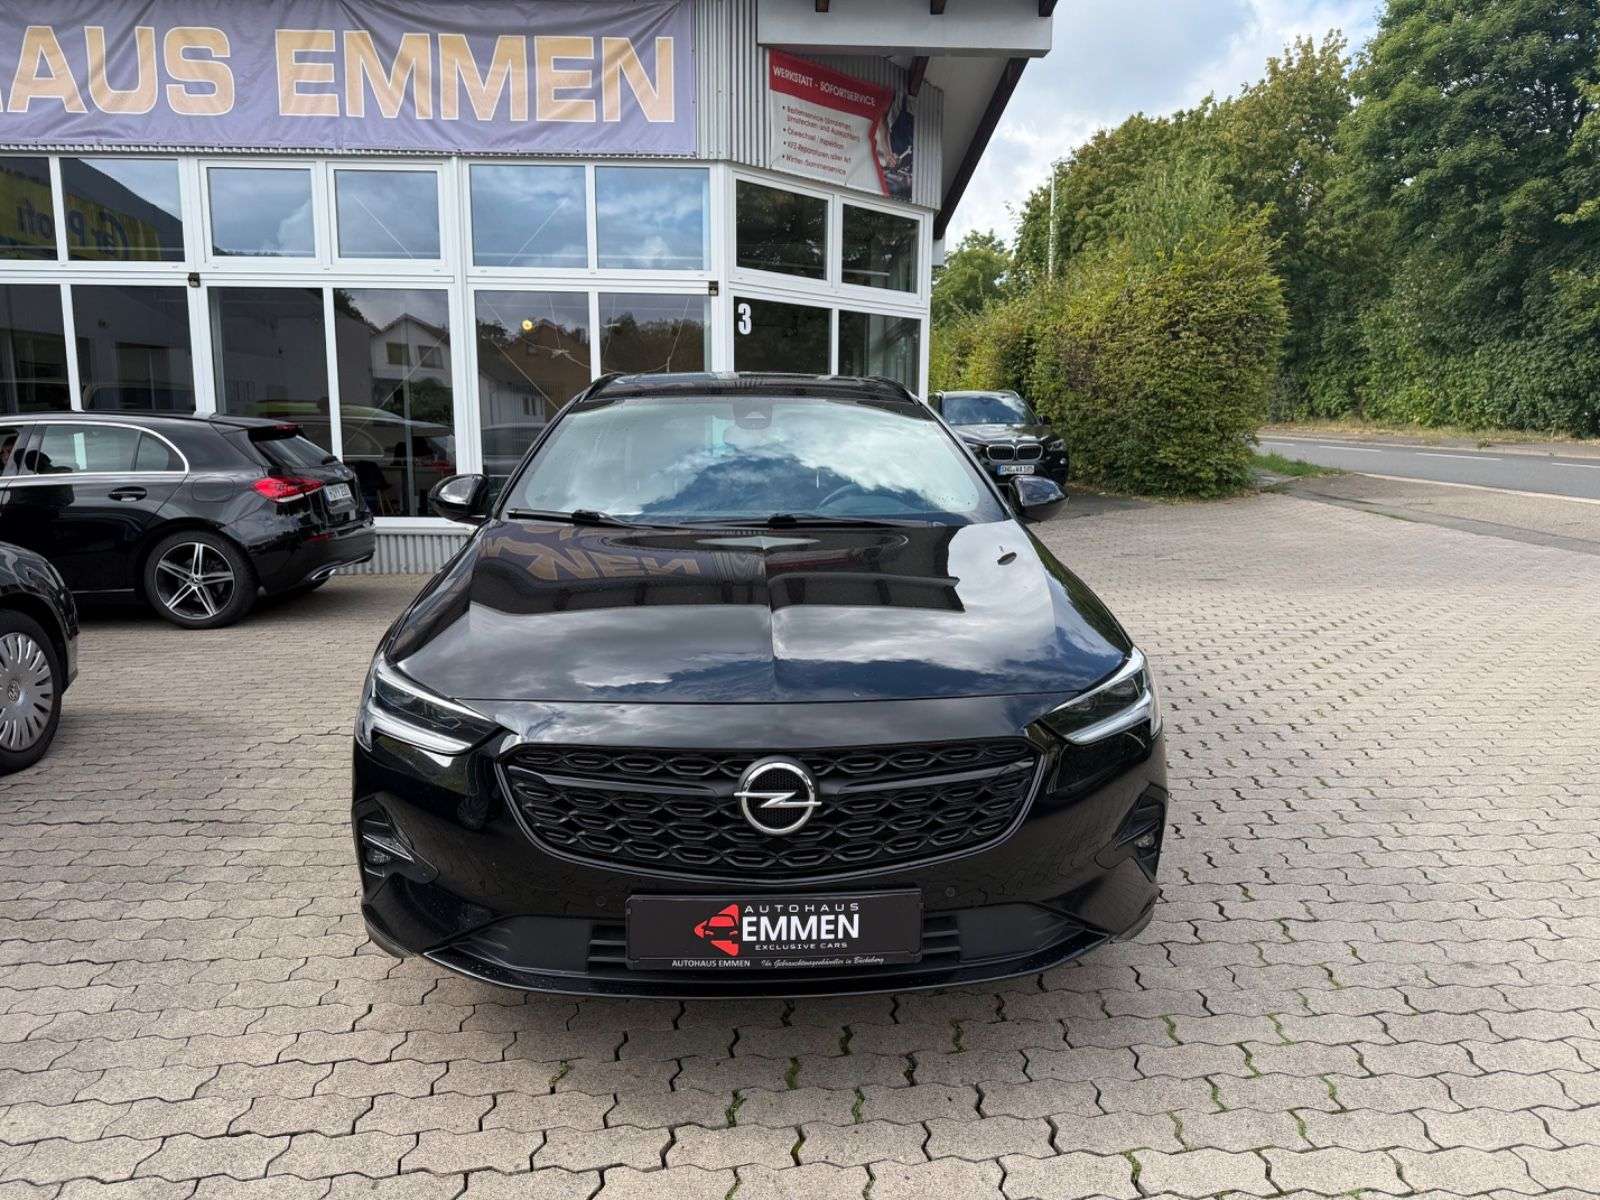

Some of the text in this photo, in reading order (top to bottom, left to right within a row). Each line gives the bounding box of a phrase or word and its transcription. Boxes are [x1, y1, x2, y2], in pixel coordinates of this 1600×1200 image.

[0, 26, 674, 122] AUS EMMEN
[773, 65, 813, 88] WERKSTATT
[820, 81, 876, 107] SOFORTSERVICE
[738, 303, 752, 335] 3
[744, 902, 859, 912] AUTOHAUS
[742, 914, 859, 941] EMMEN
